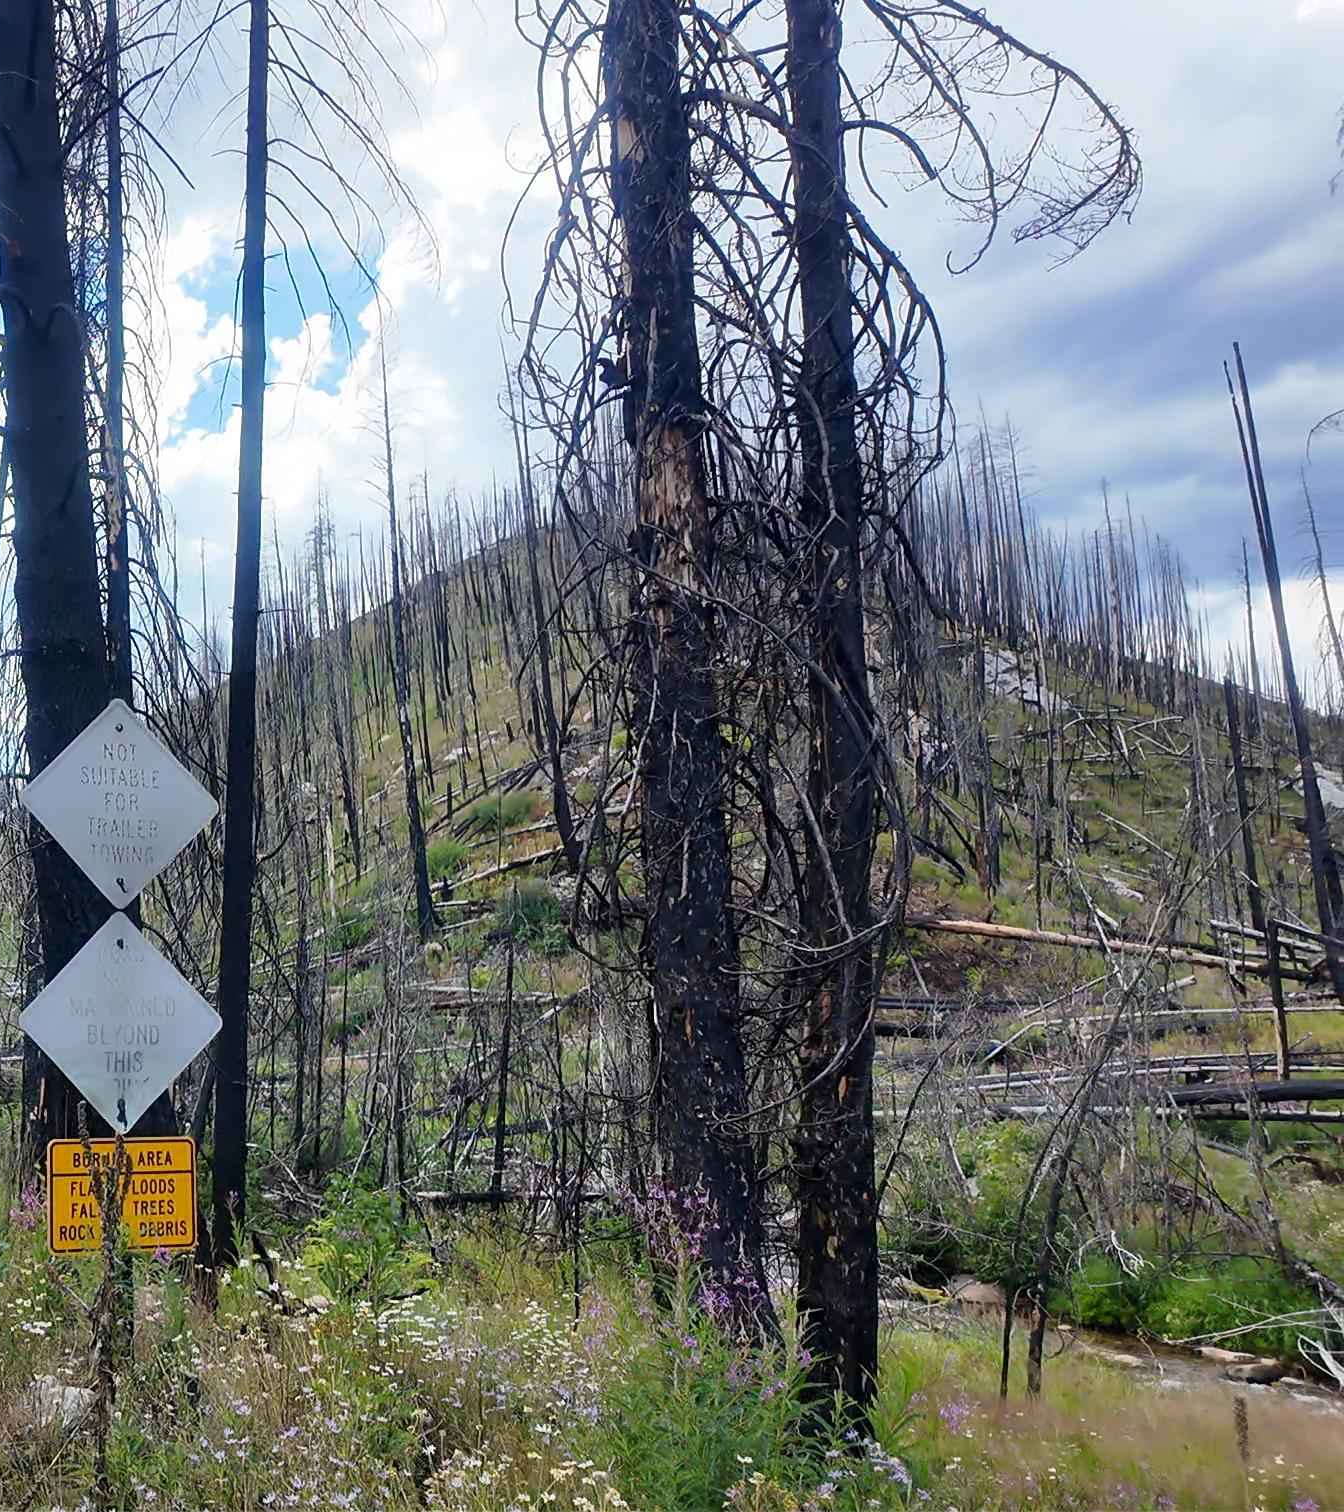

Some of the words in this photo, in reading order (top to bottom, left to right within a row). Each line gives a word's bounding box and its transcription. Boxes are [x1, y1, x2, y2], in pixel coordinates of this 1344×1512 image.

[103, 743, 137, 761] NOT
[80, 766, 160, 789] SUITABLE
[104, 791, 140, 812] FOR
[88, 815, 159, 839] TRAILER
[90, 843, 155, 865] TOWING
[87, 1024, 160, 1046] BEYOND
[103, 1051, 144, 1073] THIS
[137, 1151, 173, 1167] AREA
[124, 1179, 176, 1195] LOODS
[132, 1199, 175, 1217] TREES
[139, 1220, 188, 1238] DEBRIS
